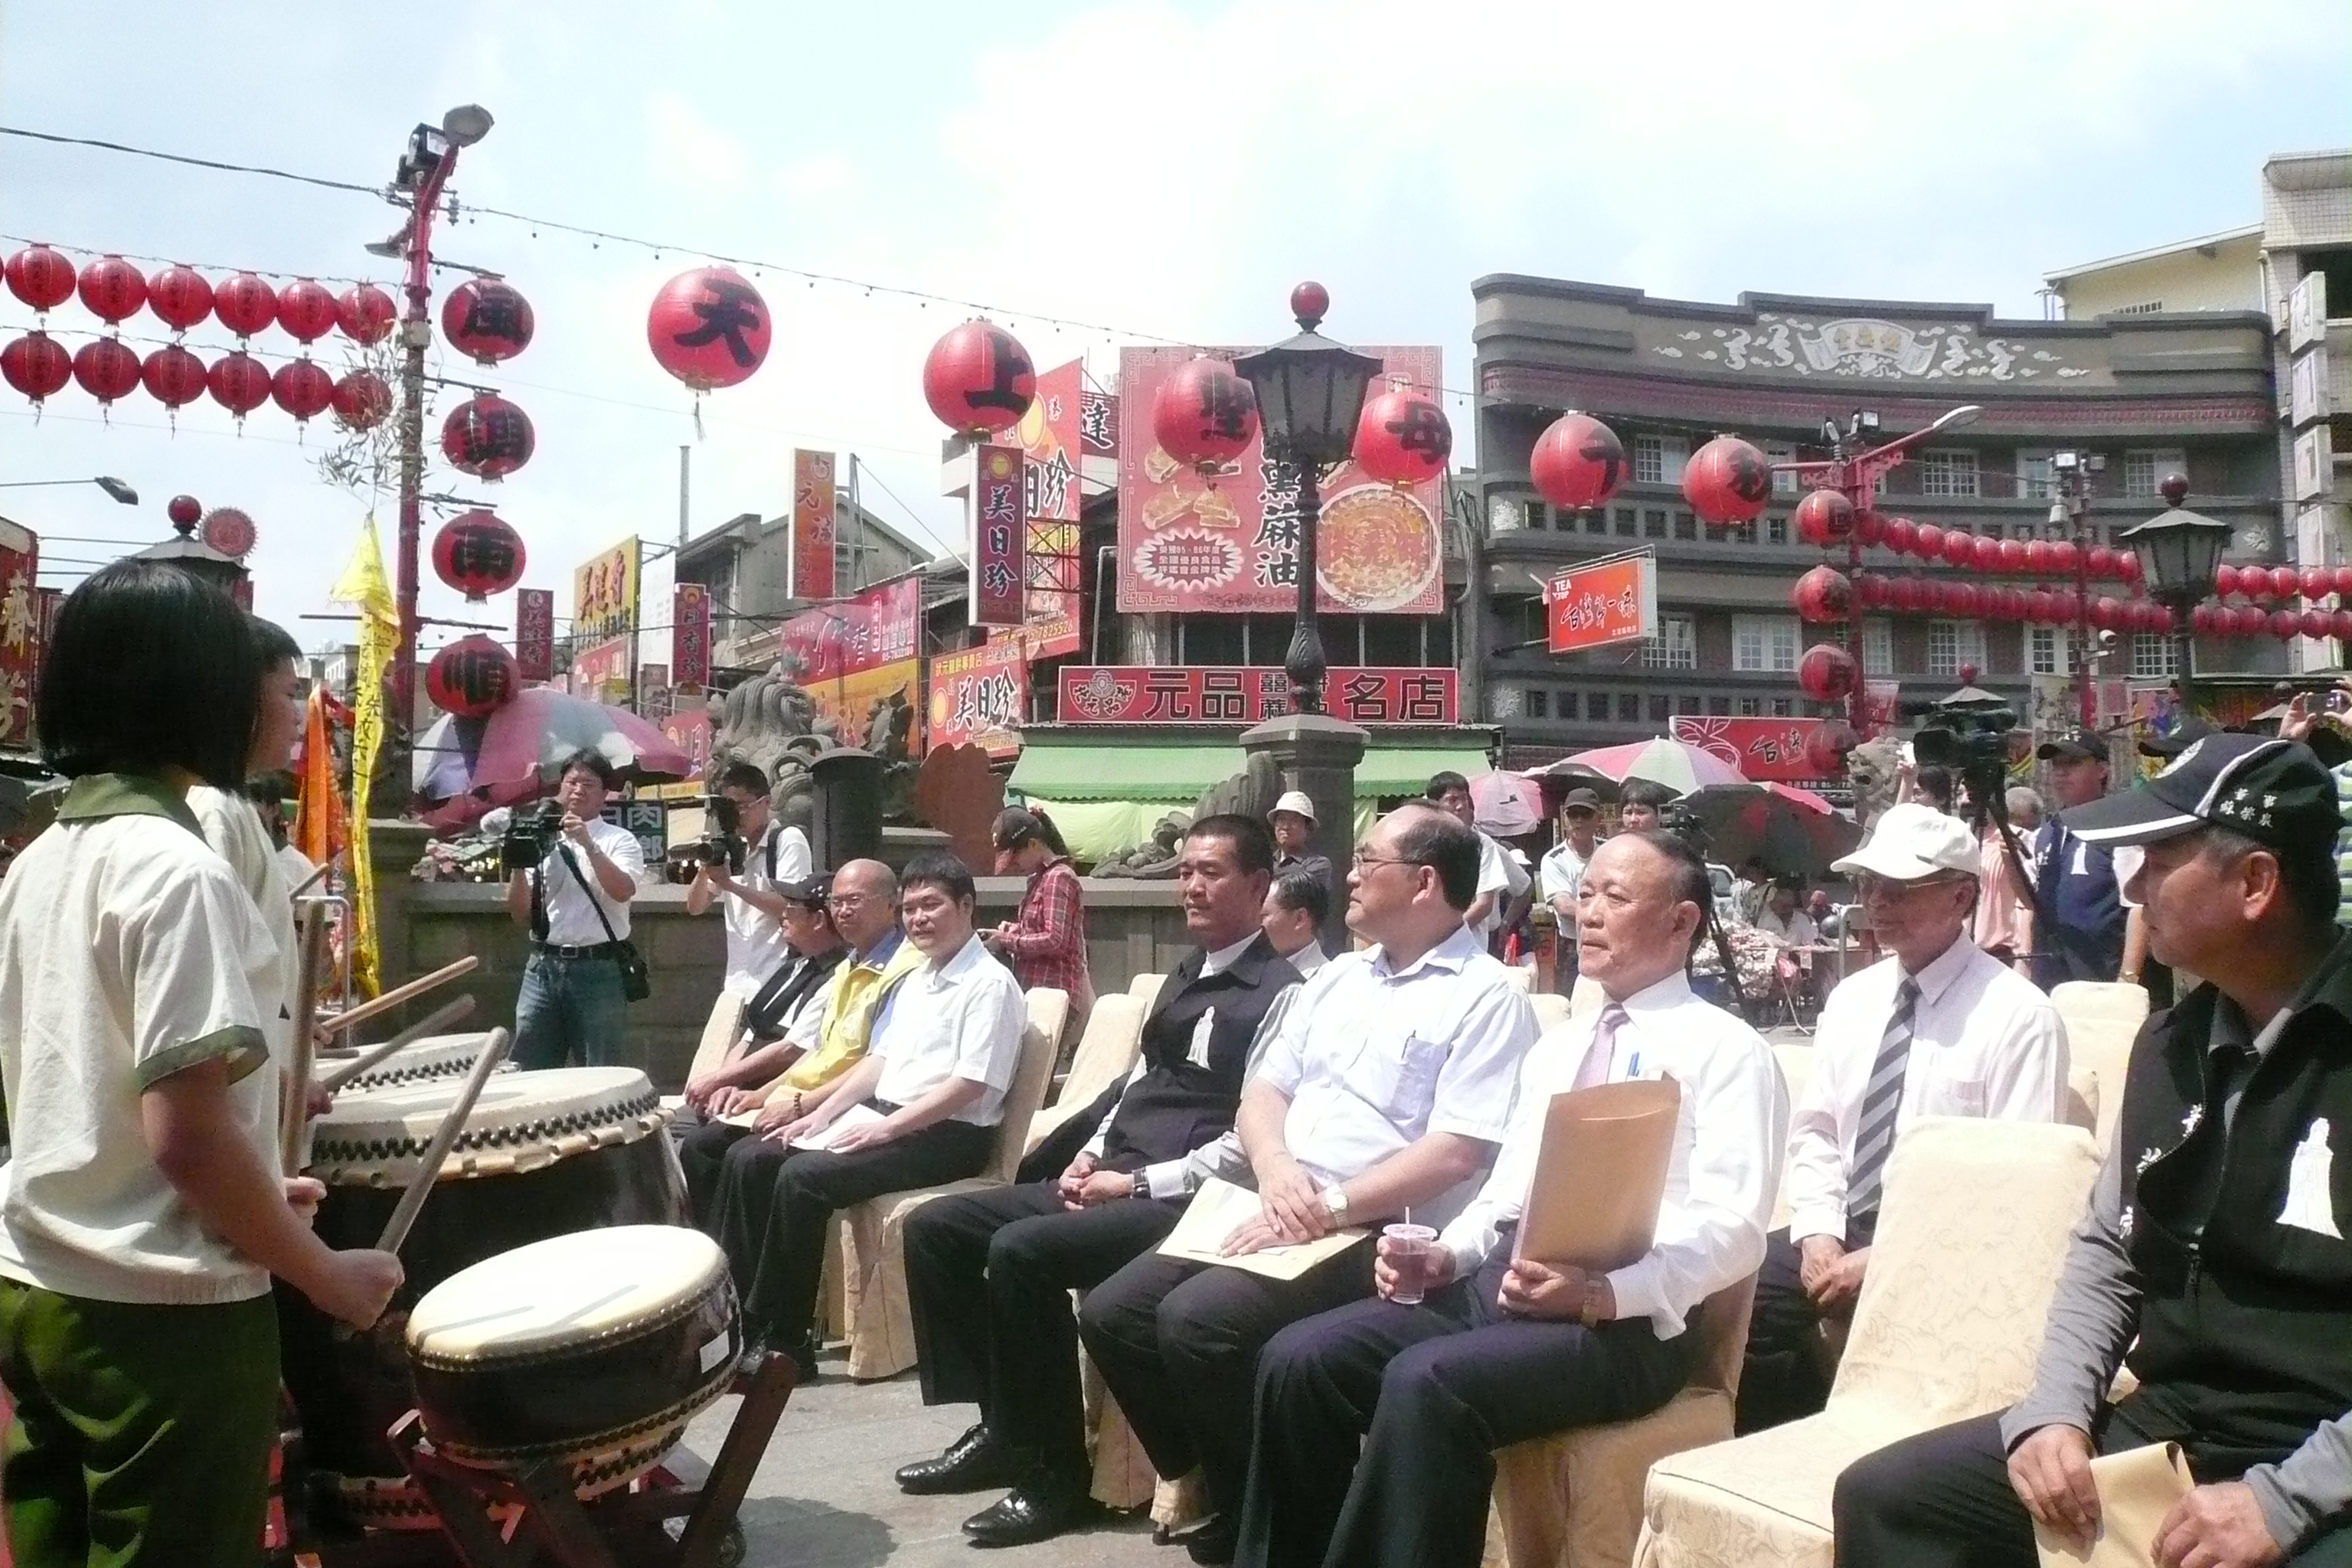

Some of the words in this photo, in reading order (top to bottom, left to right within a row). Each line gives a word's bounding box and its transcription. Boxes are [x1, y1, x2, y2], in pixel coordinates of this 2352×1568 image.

[965, 332, 1029, 416] 上
[983, 484, 1019, 597] 美日珍
[1555, 579, 1572, 592] TEA
[954, 665, 1018, 732] 美日珍
[1144, 671, 1246, 720] 元品
[1342, 672, 1446, 721] 名店
